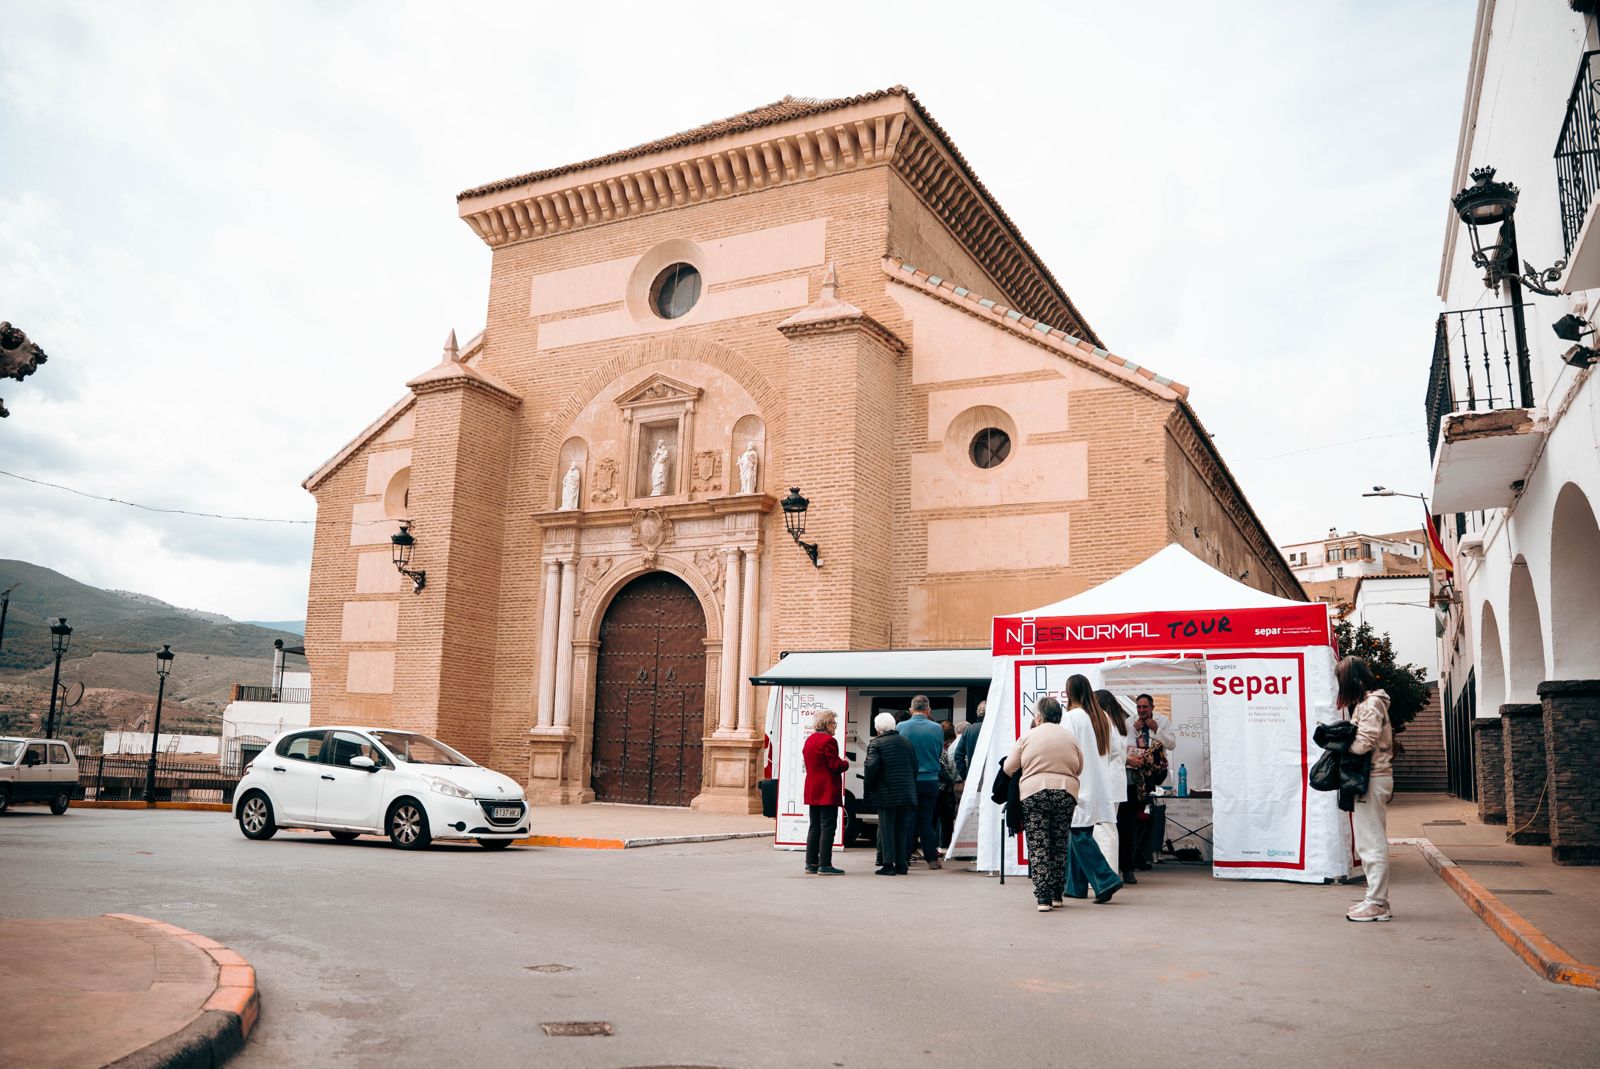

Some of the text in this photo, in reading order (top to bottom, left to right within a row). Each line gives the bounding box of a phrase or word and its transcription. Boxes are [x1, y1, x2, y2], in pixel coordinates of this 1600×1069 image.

[1167, 616, 1232, 639] TOUR
[1254, 627, 1281, 636] separ
[1212, 675, 1292, 701] separ
